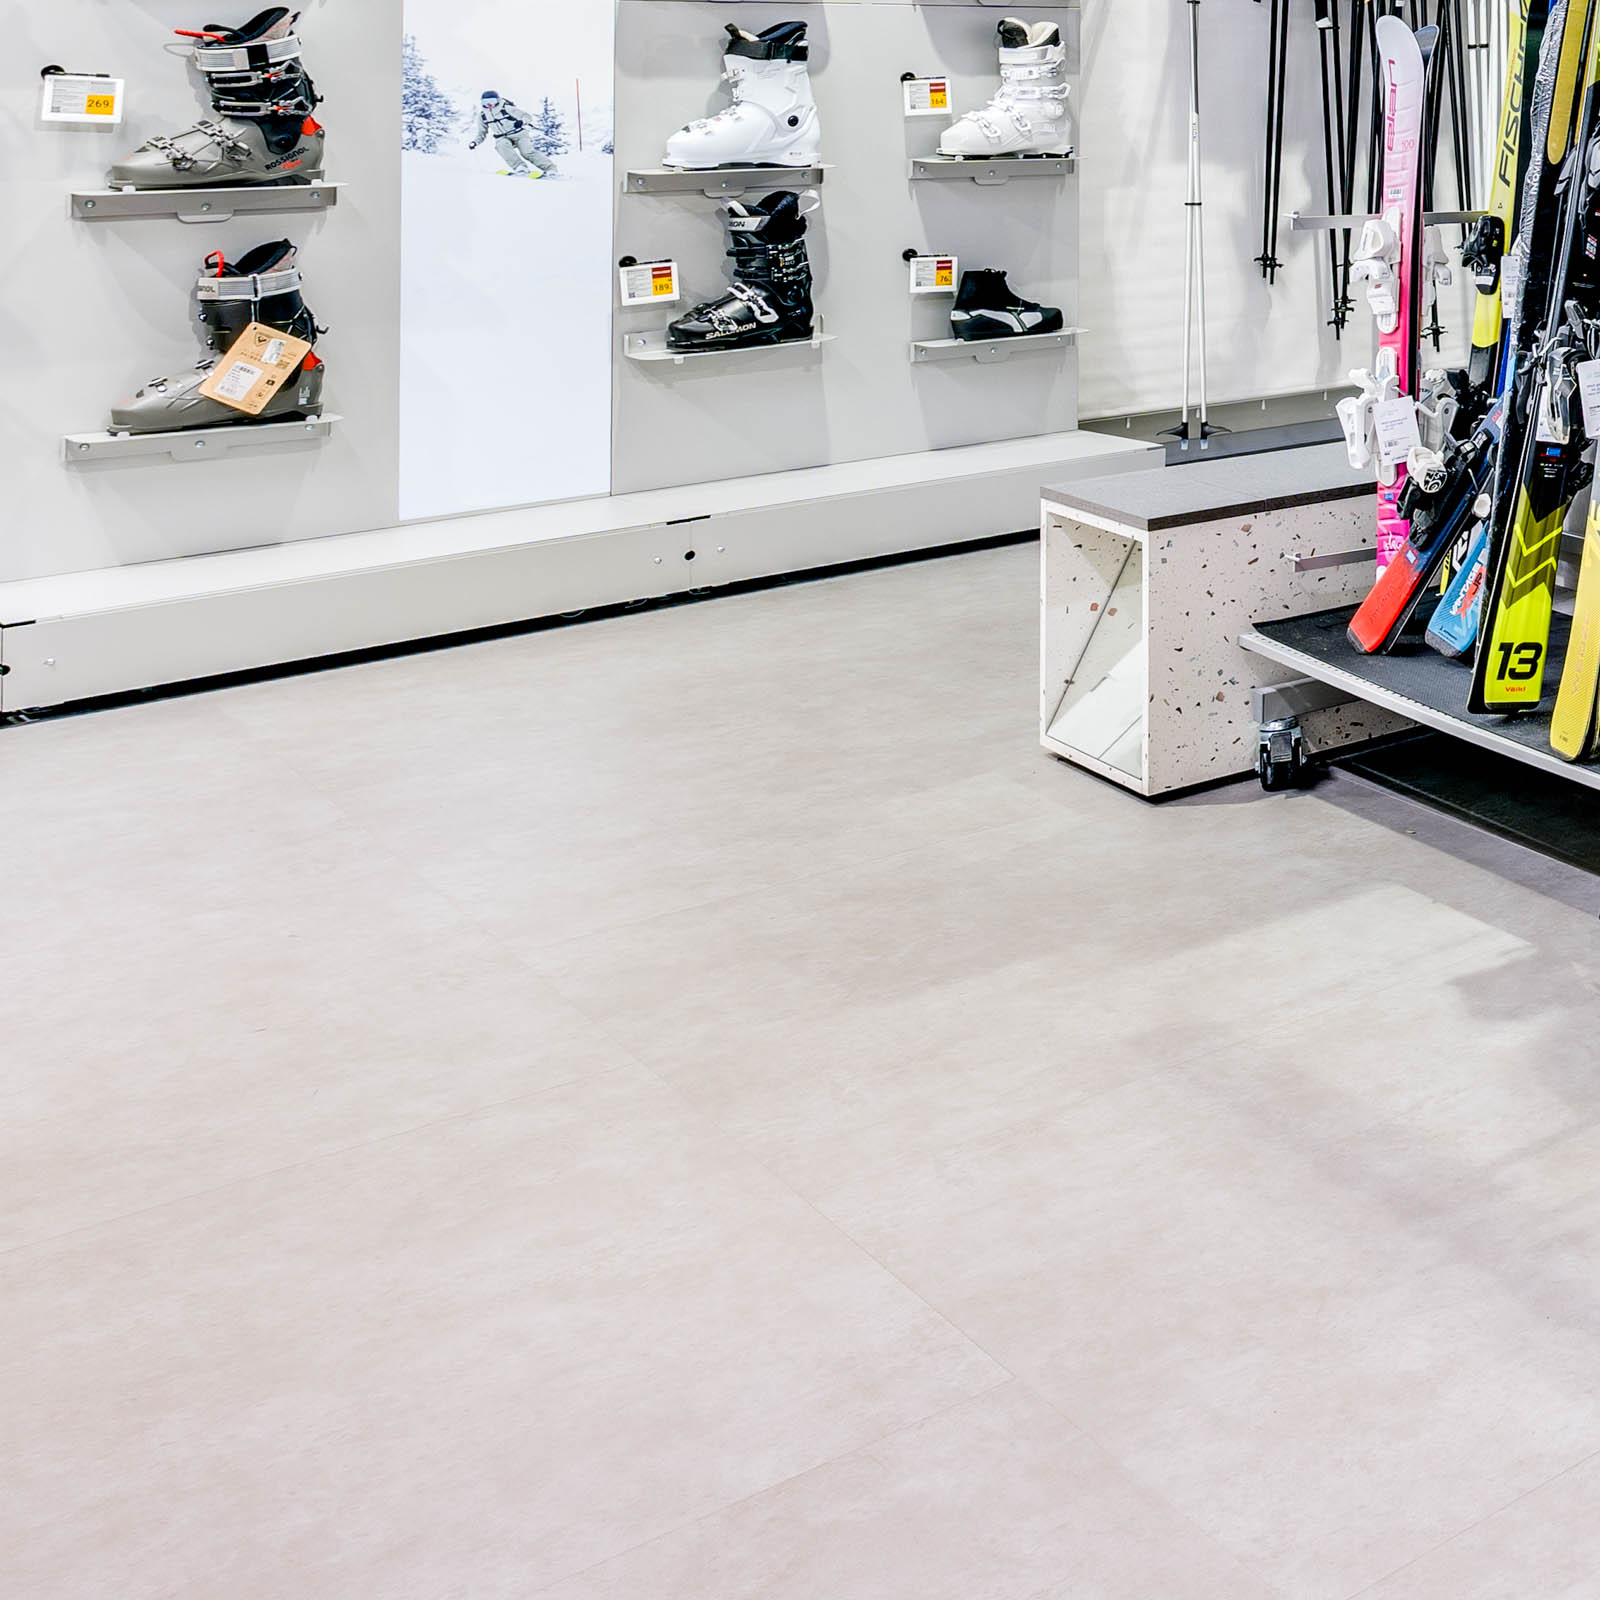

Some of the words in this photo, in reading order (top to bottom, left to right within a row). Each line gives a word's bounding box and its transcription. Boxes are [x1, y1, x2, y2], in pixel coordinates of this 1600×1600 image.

[265, 146, 309, 171] ROSSIGNOL
[705, 322, 756, 340] SALOMON
[1496, 642, 1543, 681] 13
